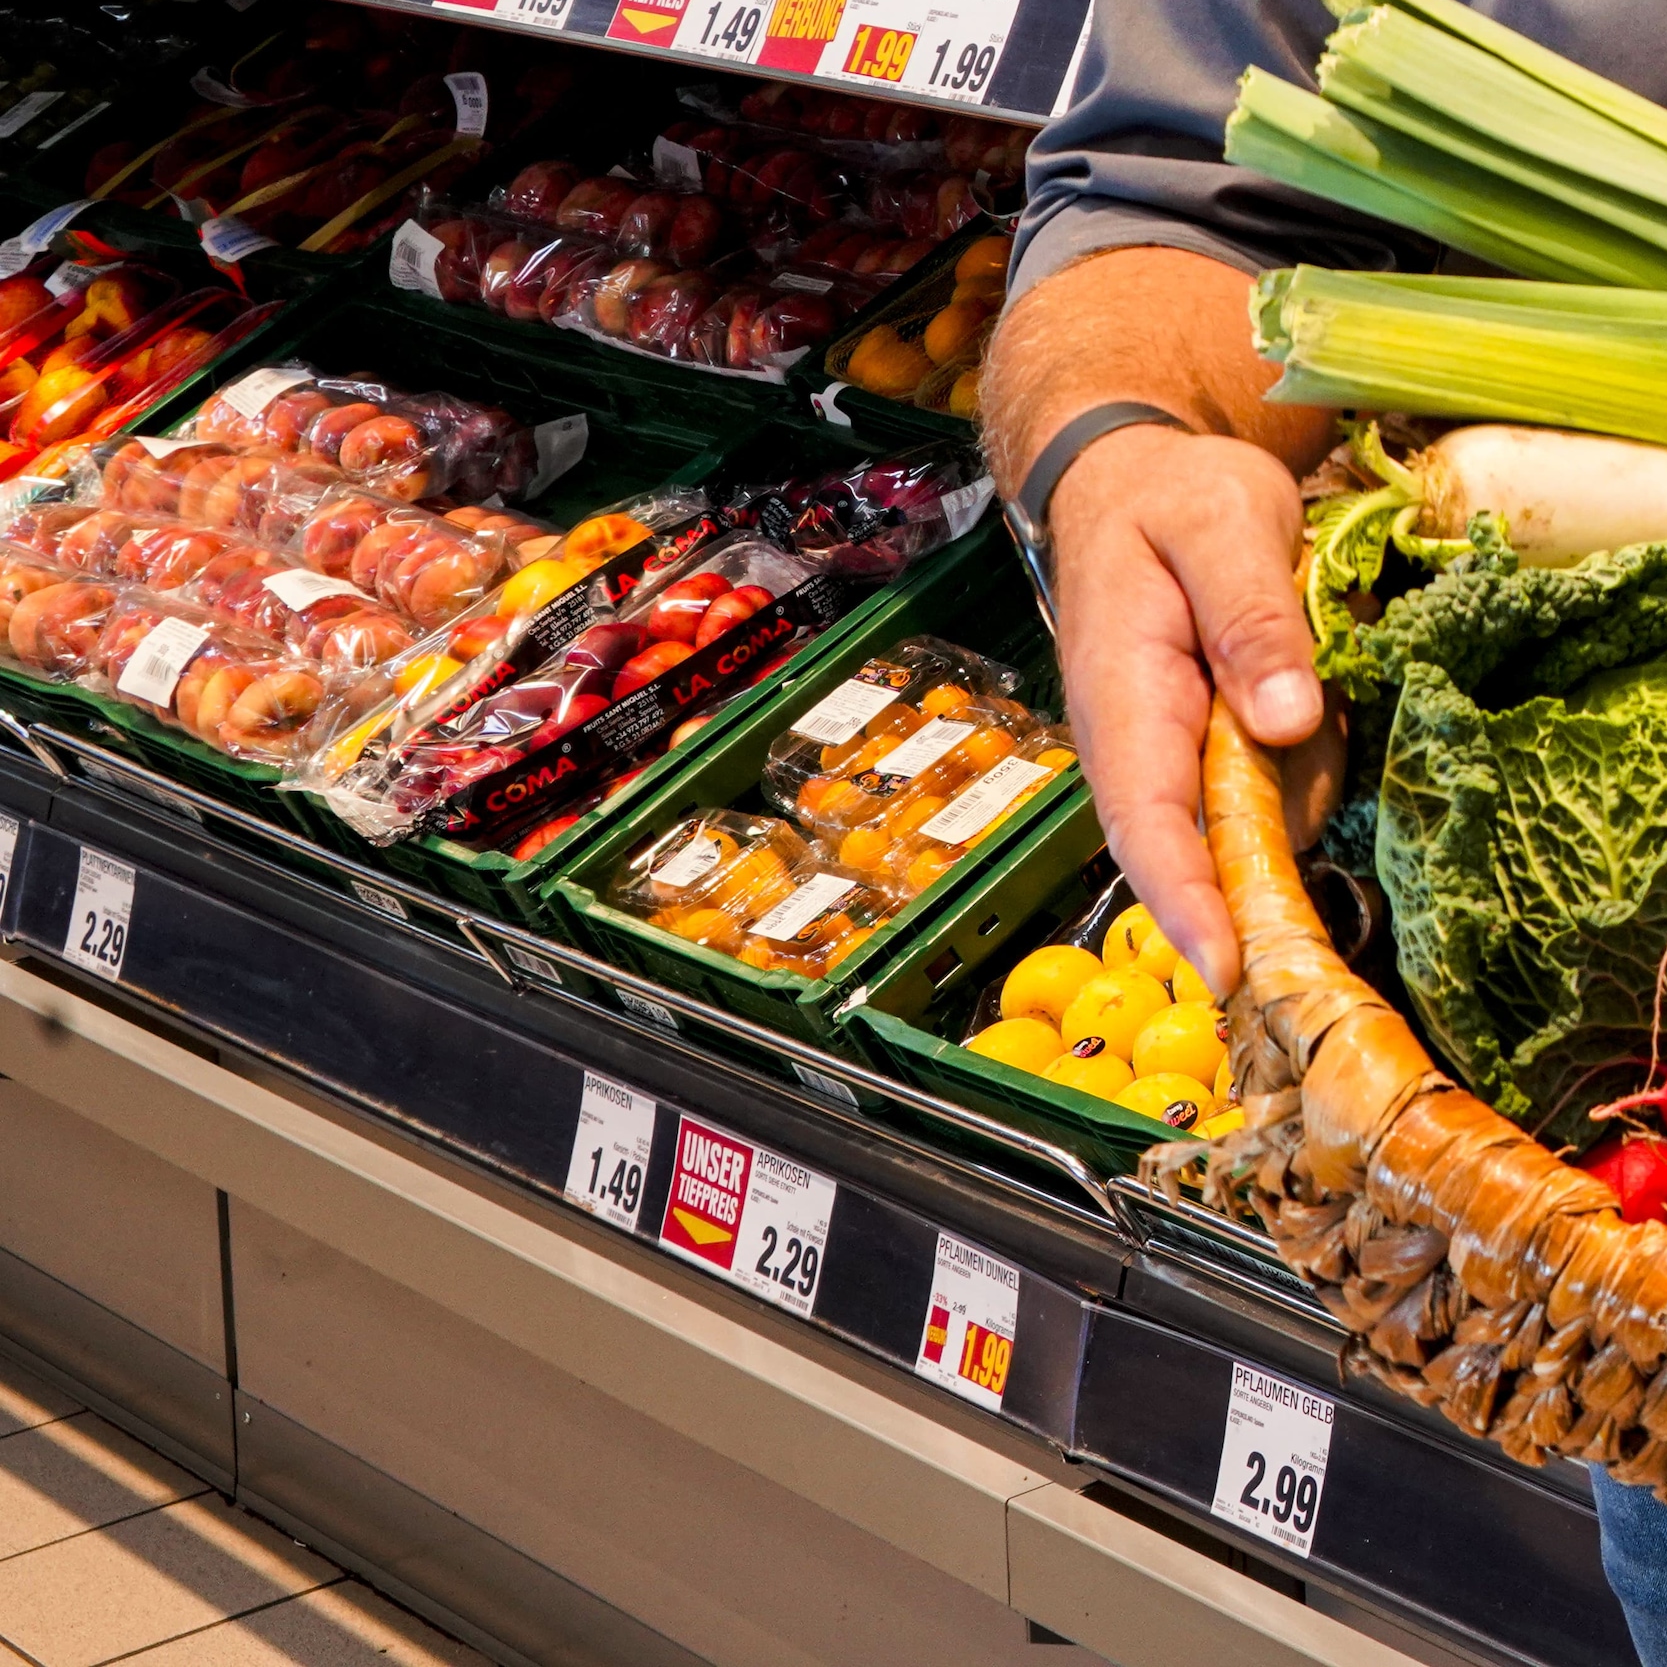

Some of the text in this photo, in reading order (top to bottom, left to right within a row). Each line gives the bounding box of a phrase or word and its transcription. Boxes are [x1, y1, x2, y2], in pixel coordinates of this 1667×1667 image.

[700, 1, 761, 53] 1.49
[906, 21, 922, 32] Stück
[989, 33, 1004, 43] Stück
[849, 26, 914, 81] 1.99
[928, 38, 996, 92] 1.99
[603, 519, 719, 604] LA COMA
[552, 591, 577, 610] MIQUEL
[795, 581, 814, 598] FRUITS
[671, 618, 793, 706] LA COMA
[583, 690, 648, 733] FRUITS SANT MIQUEL
[626, 722, 639, 734] 973
[638, 715, 650, 727] 797
[637, 693, 658, 708] 25181
[486, 755, 578, 812] COMA
[80, 911, 125, 966] 2.29
[584, 1076, 633, 1111] APRIKOSEN
[588, 1146, 642, 1213] 1.49
[682, 1131, 744, 1194] UNSER
[757, 1152, 811, 1189] APRIKOSEN
[677, 1172, 739, 1225] TIEFPREIS
[755, 1225, 819, 1297] 2.29
[937, 1257, 971, 1279] SORTE ANGEBEN
[939, 1237, 1019, 1291] PFLAUMEN DUNKEL
[932, 1293, 948, 1306] -33%
[985, 1317, 1014, 1338] Kilogramm
[963, 1324, 1010, 1393] 1.99
[1233, 1388, 1273, 1413] SORTE ANGEBEN
[1235, 1367, 1334, 1425] PFLAUMEN GELB
[1290, 1453, 1325, 1477] Kilogramm
[1240, 1451, 1318, 1534] 2.99
